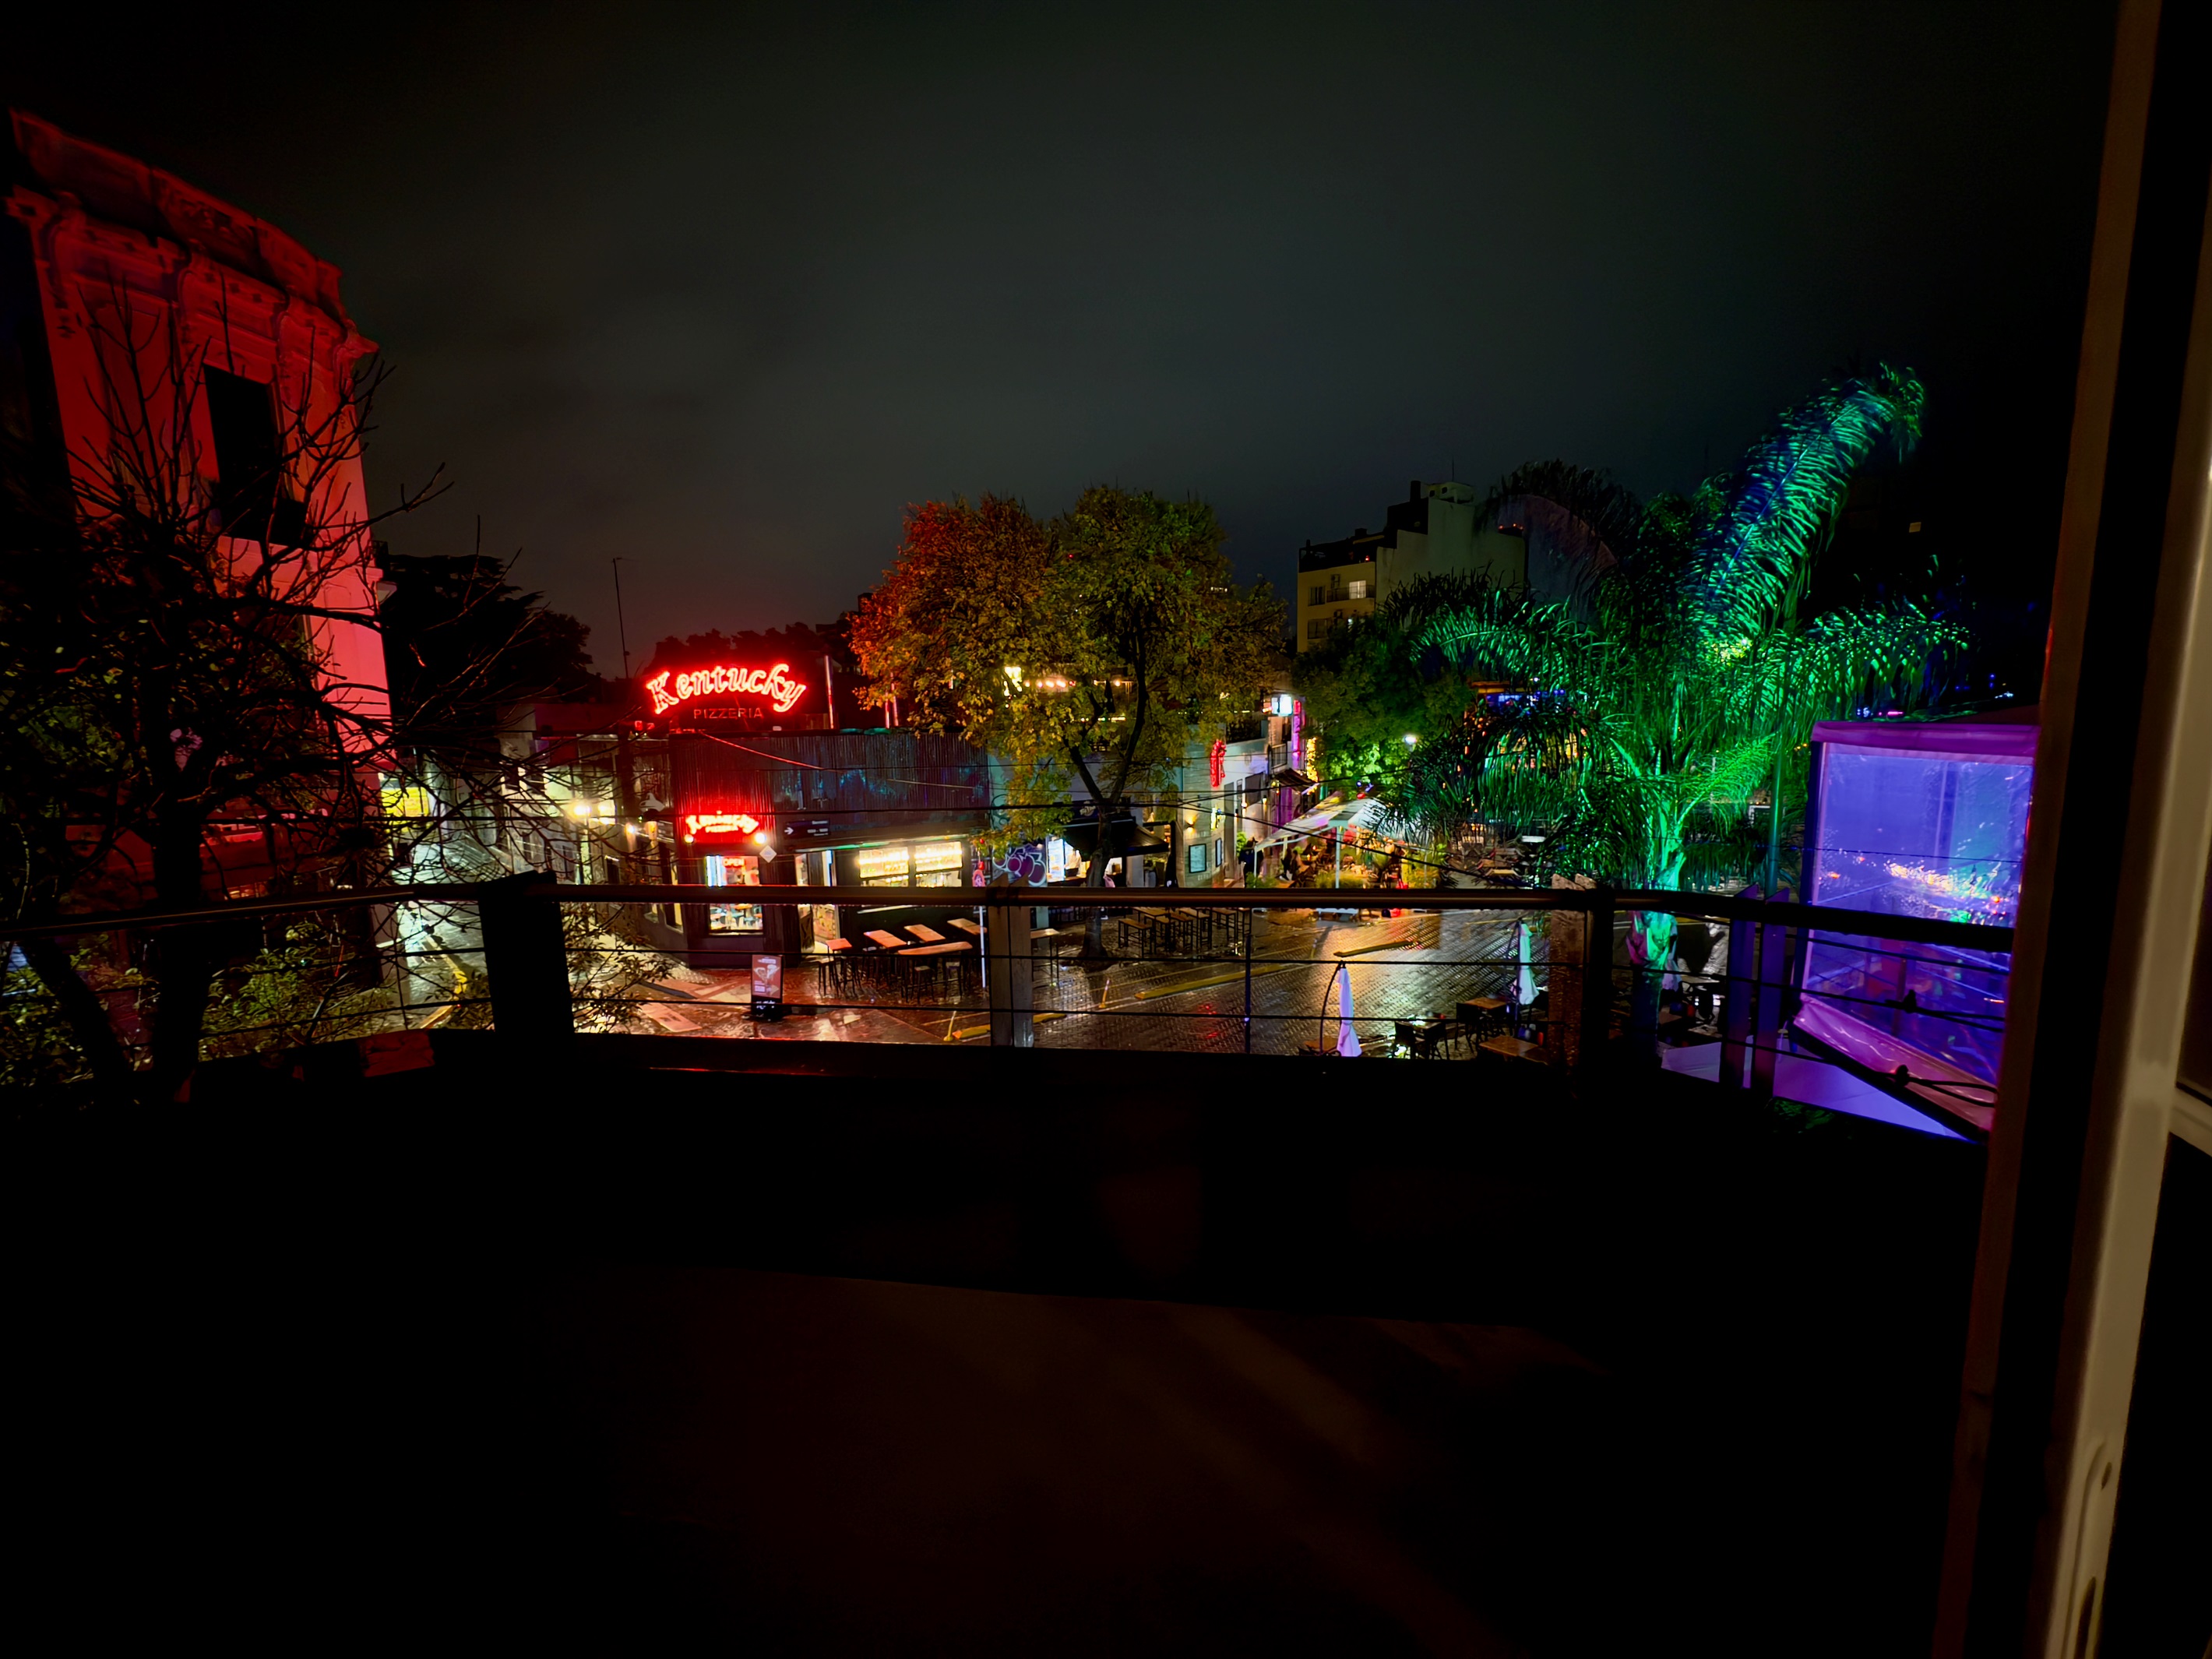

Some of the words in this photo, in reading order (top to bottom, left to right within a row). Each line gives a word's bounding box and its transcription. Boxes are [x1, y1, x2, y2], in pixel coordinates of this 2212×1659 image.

[646, 663, 806, 714] Kentucky
[693, 707, 764, 720] PIZZERIA
[723, 858, 745, 867] OPEN
